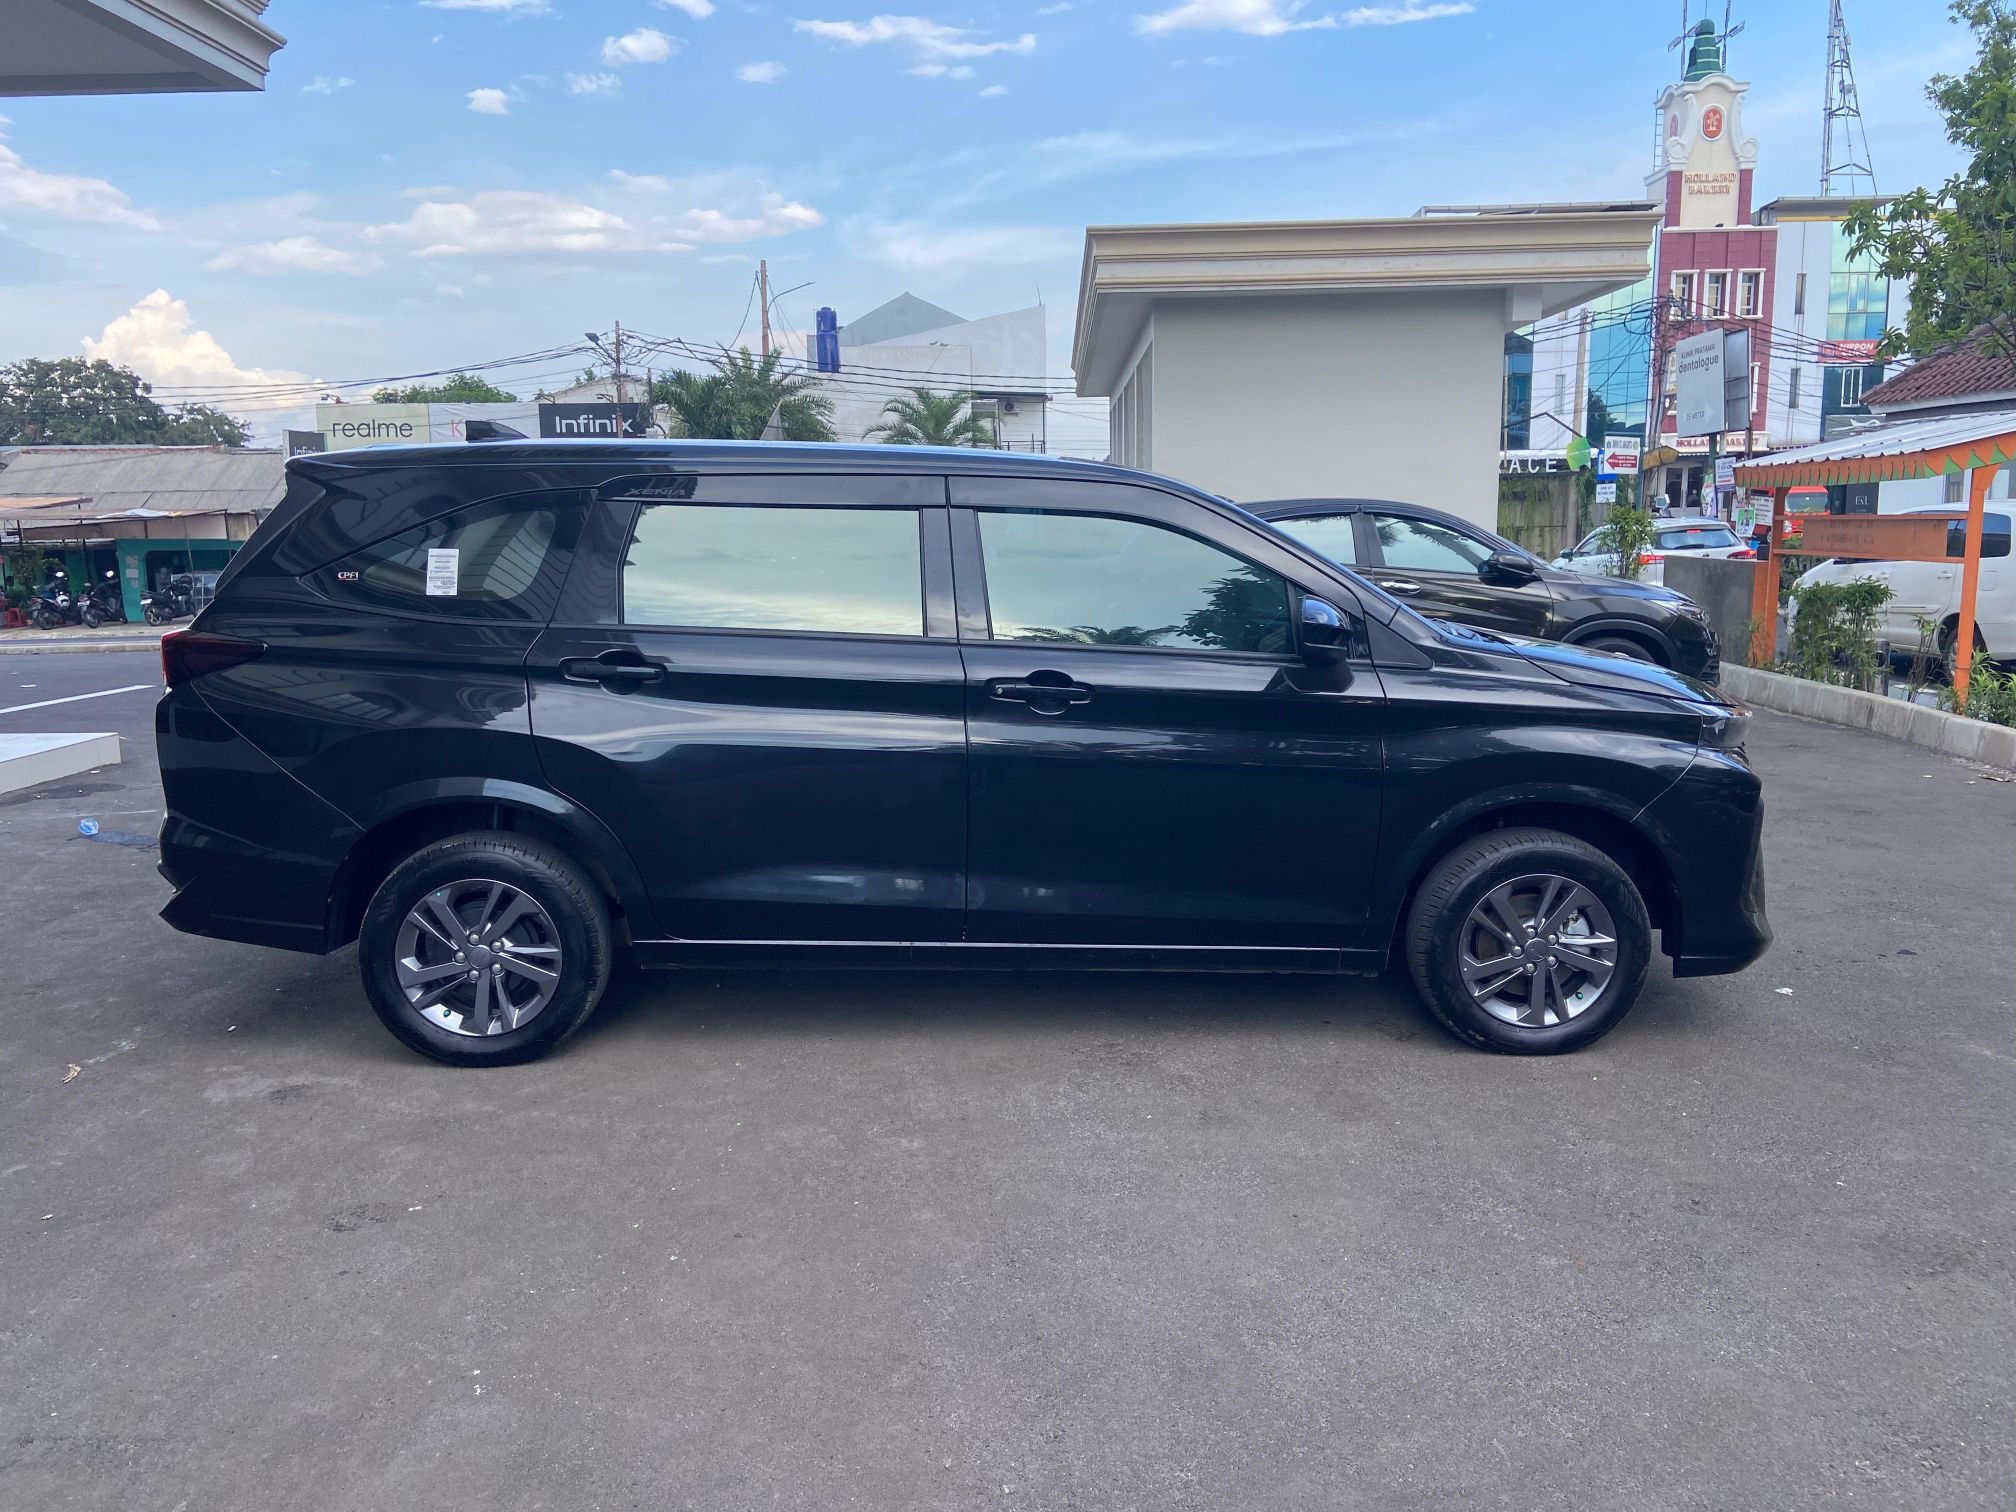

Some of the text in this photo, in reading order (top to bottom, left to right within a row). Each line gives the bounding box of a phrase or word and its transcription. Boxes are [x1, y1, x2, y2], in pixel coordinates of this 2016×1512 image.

[1684, 173, 1736, 183] HOLLAND
[1688, 185, 1730, 195] BAKERY
[1694, 343, 1715, 355] PRATAMA
[1679, 354, 1719, 373] dentalogue
[332, 419, 413, 438] realme
[555, 415, 634, 433] Infinix
[1499, 457, 1557, 474] ACE
[623, 488, 686, 496] XENIA
